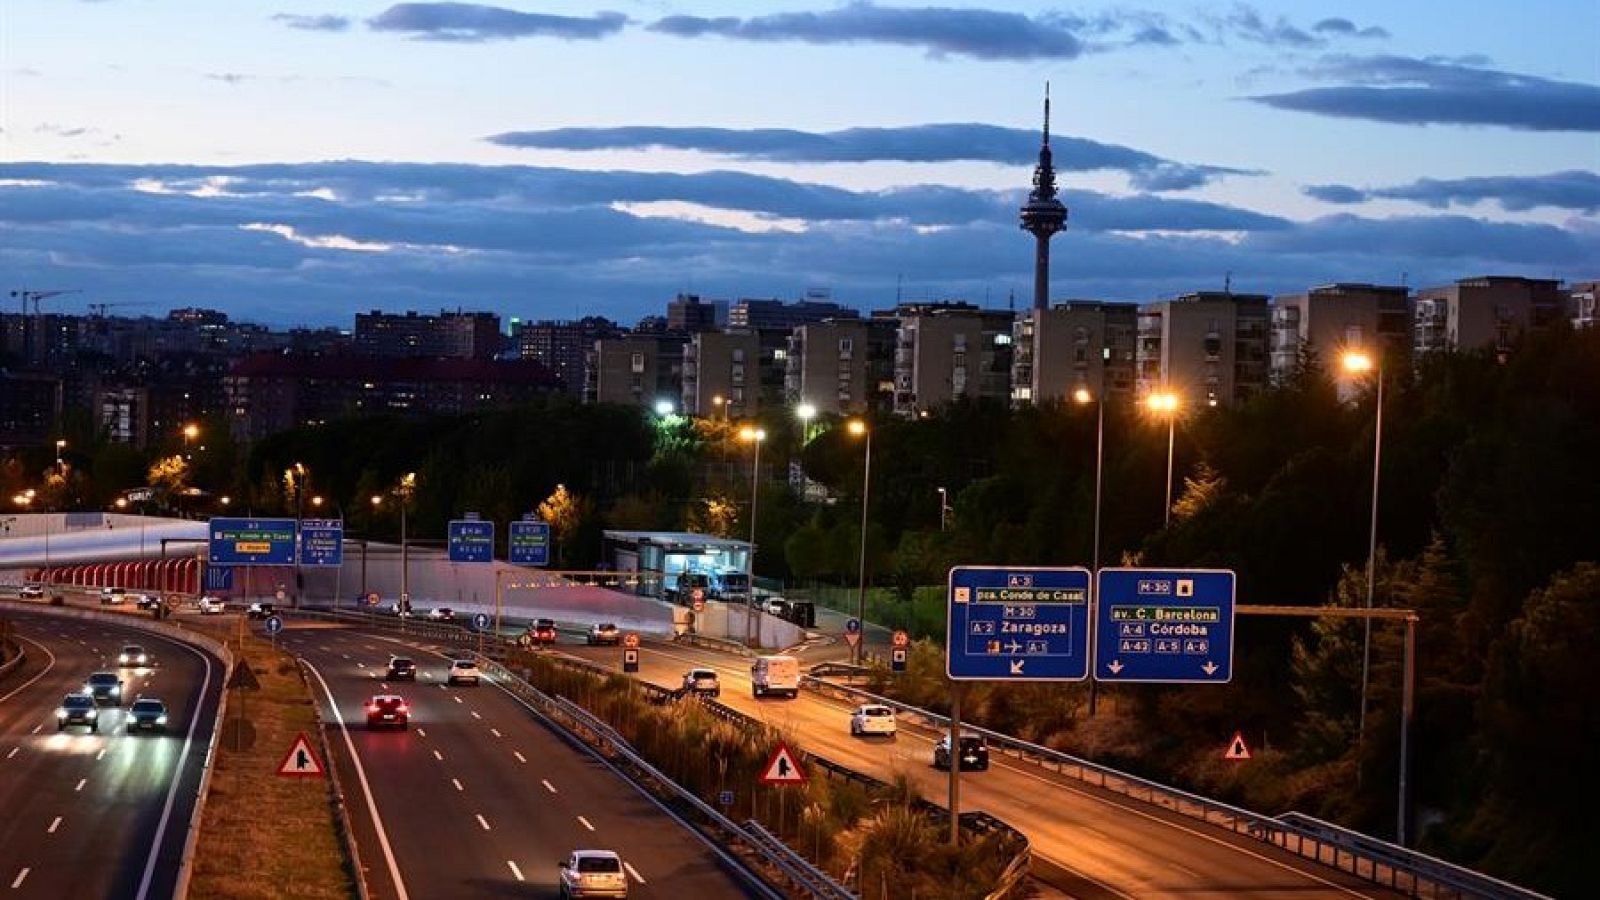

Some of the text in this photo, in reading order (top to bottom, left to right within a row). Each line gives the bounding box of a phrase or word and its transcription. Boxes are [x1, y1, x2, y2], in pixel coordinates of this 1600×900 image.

[1011, 577, 1031, 586] A-3
[1140, 582, 1169, 592] M-30
[1005, 607, 1034, 617] M-30
[1155, 608, 1217, 620] Barcelona
[973, 621, 1066, 635] A-2 Zaragoza
[1123, 622, 1208, 635] A-4 Córdoba
